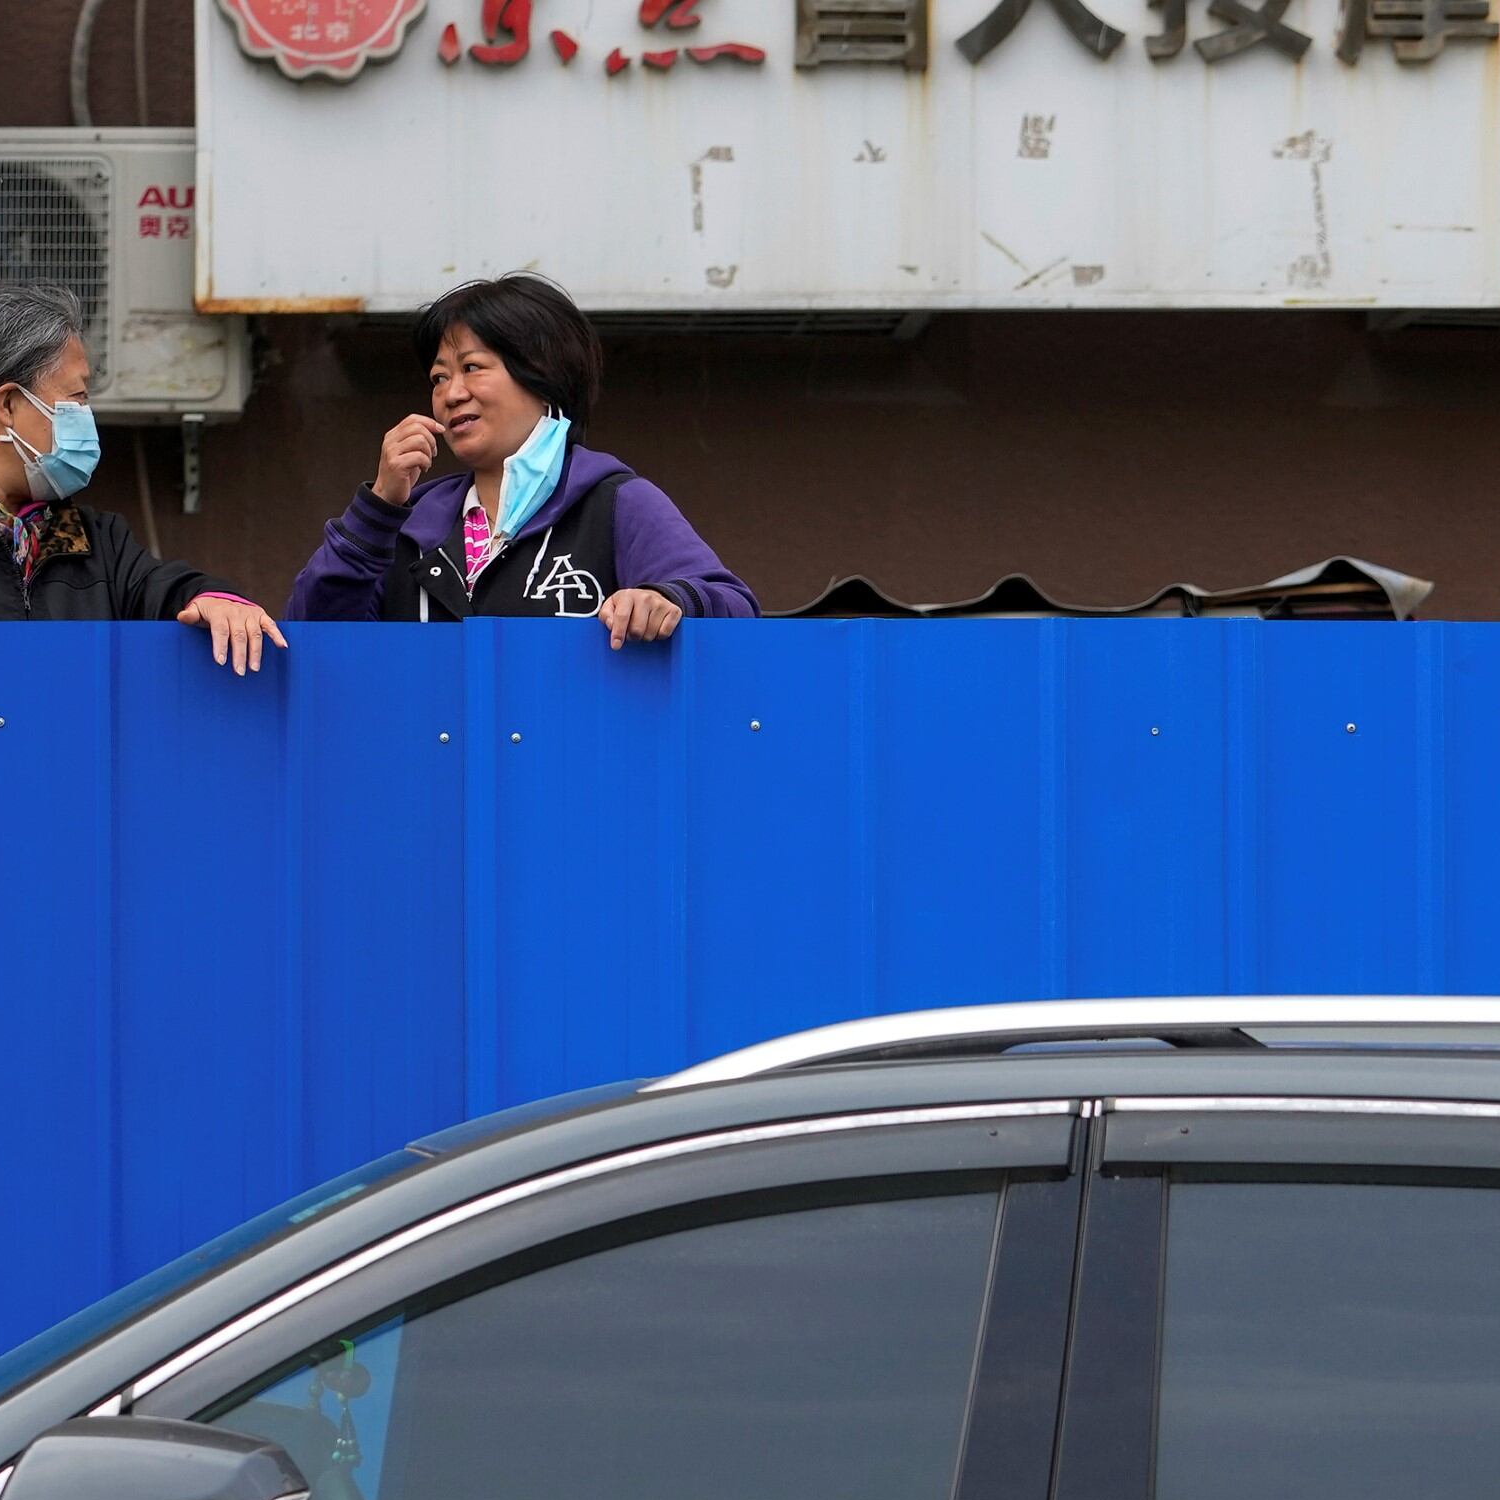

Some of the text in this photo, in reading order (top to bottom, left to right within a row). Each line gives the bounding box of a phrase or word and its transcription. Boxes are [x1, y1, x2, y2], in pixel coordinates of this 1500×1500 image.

[289, 21, 350, 43] 北京
[137, 186, 196, 209] AU
[139, 214, 190, 239] 奥克
